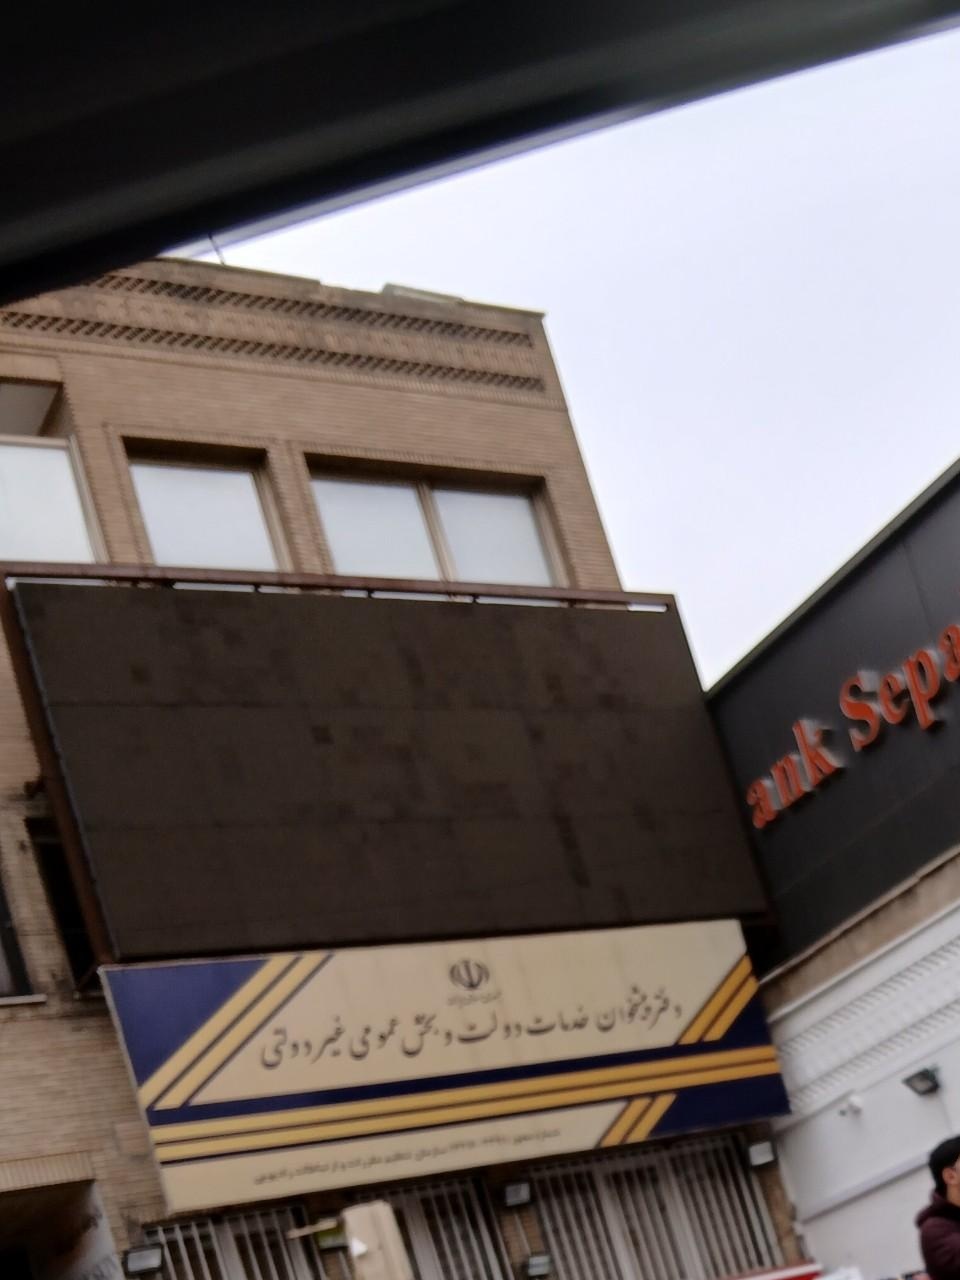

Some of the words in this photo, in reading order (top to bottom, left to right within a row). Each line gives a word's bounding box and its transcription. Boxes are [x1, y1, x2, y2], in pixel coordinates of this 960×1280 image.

[747, 719, 845, 829] ank
[350, 1015, 399, 1061] عمومی
[401, 1013, 439, 1058] بخش
[457, 1007, 522, 1043] دولت
[526, 1004, 589, 1037] خدمات
